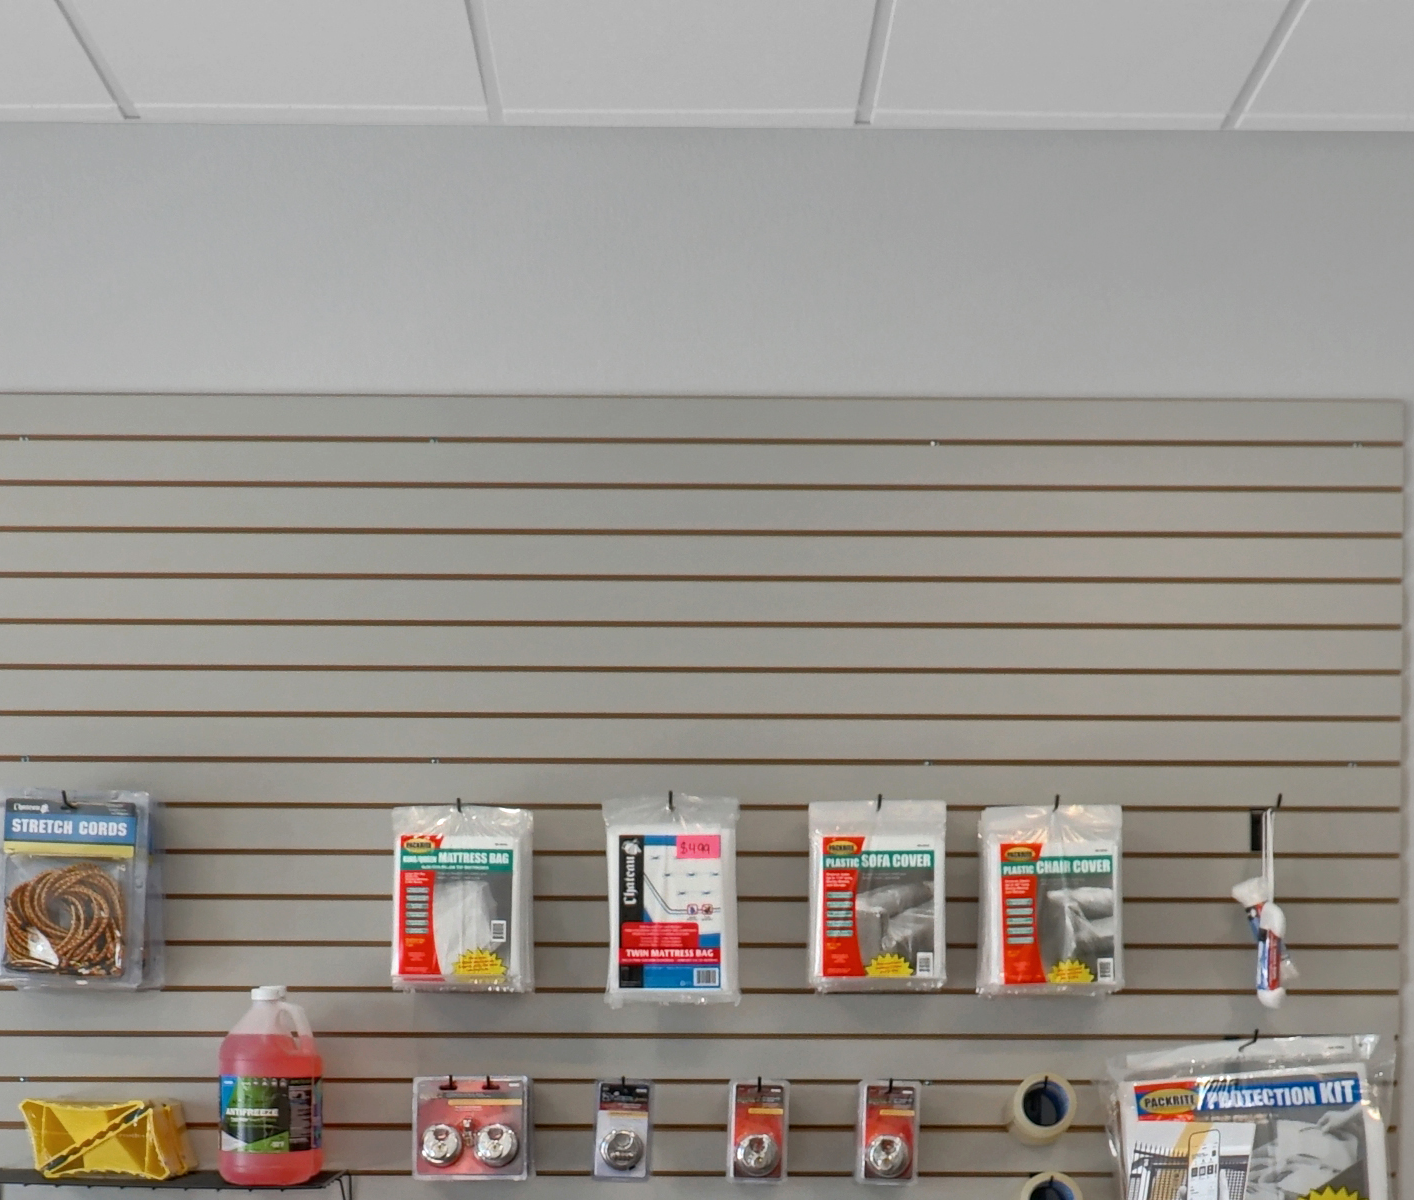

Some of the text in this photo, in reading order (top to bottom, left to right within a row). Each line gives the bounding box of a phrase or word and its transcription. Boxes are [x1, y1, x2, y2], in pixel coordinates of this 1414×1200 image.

[12, 818, 128, 836] STRETCH CORDS
[438, 852, 509, 864] MATTRESS BAG
[826, 854, 931, 868] PLASTIC SOFA COVER
[1003, 859, 1111, 875] PLASTIC CHAIR COVER
[623, 855, 637, 905] Chateau
[626, 949, 713, 957] TWIN MATTRESS BAG
[1207, 1080, 1355, 1109] PROTECTION KIT
[226, 1108, 279, 1116] ANTIFREEZE
